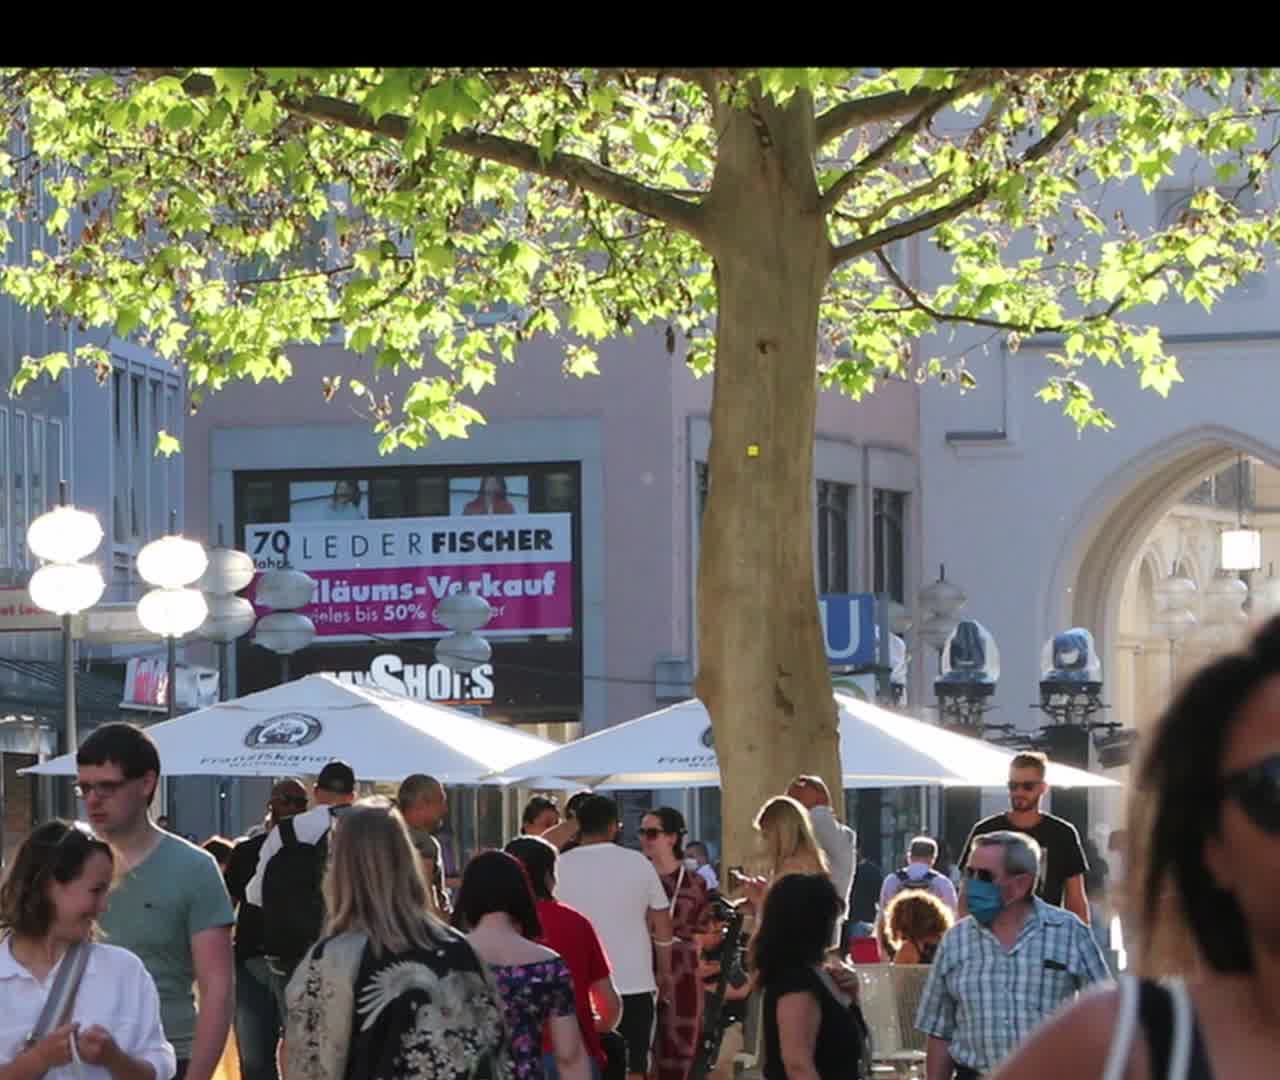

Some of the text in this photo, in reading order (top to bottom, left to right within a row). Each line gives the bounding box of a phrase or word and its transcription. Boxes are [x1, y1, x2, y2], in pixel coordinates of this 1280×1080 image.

[253, 530, 290, 554] 70
[303, 529, 553, 559] LEDER FISCHER
[355, 604, 379, 623] bis
[383, 603, 426, 621] 50%
[819, 599, 861, 659] U
